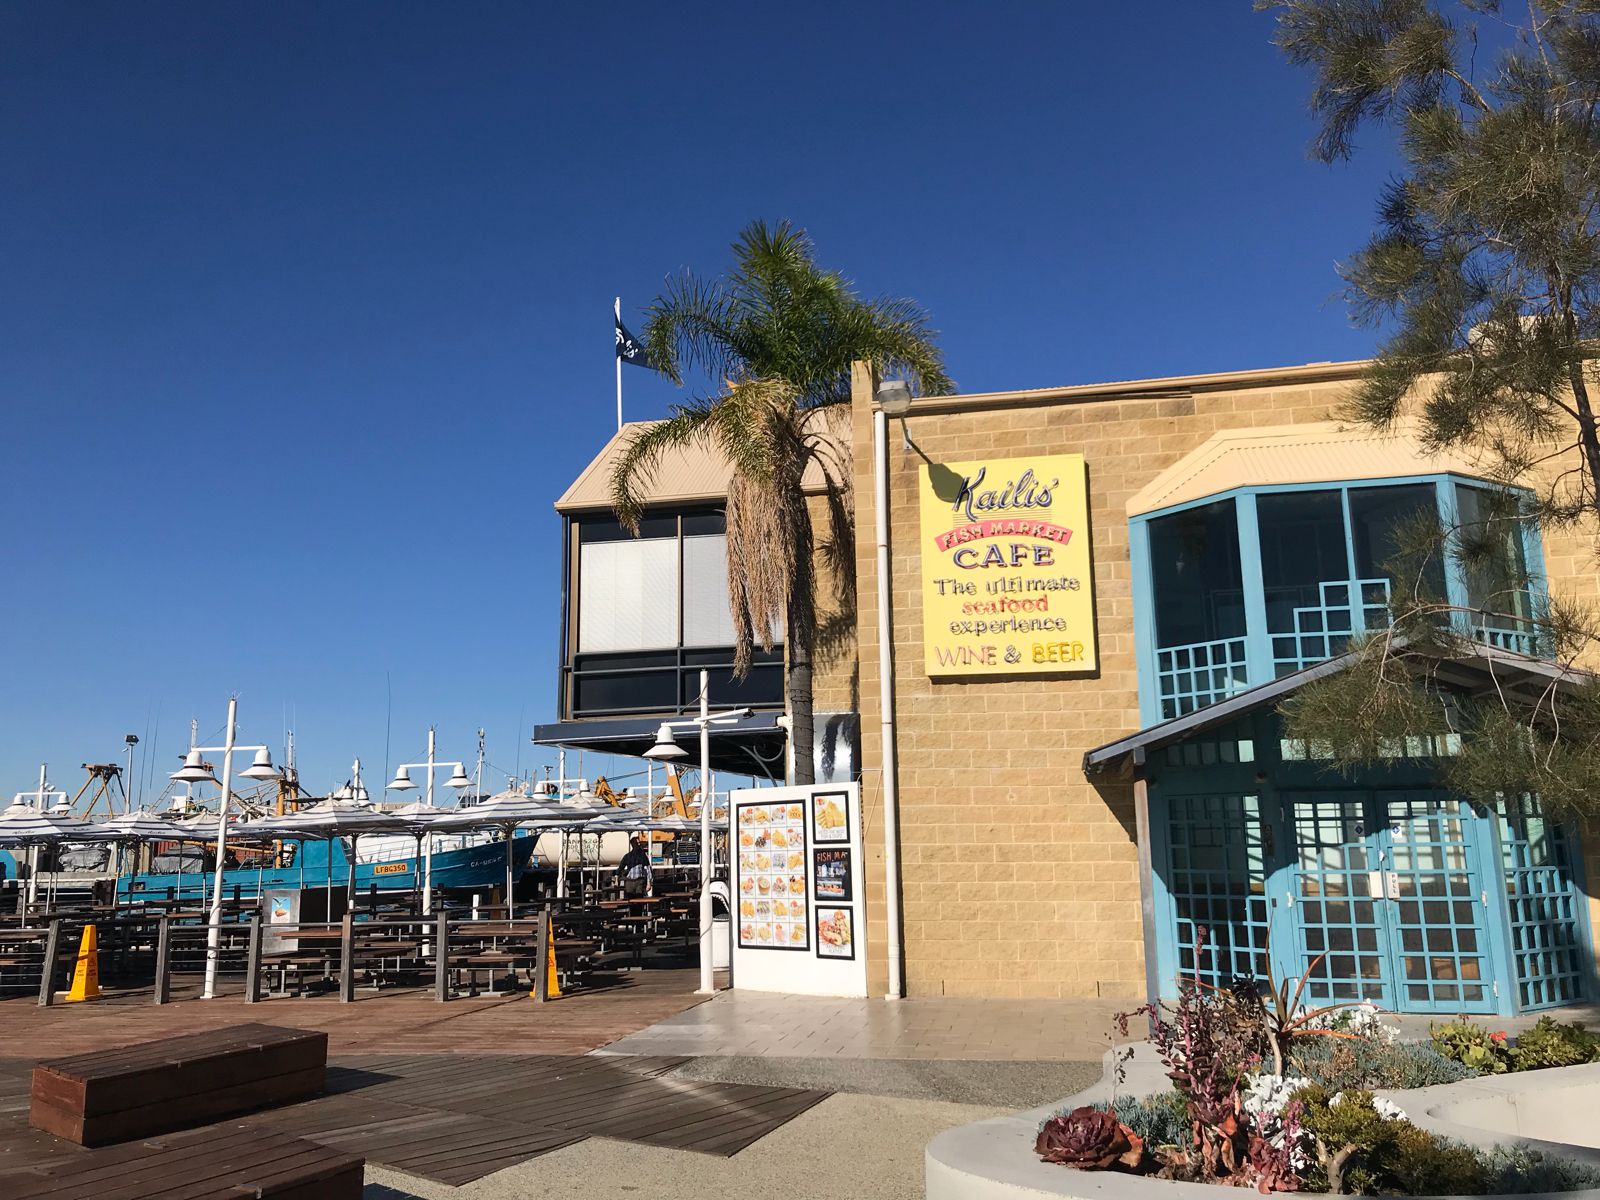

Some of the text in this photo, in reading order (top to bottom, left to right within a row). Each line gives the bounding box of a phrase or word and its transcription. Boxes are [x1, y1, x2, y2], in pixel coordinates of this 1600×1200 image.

[953, 464, 1060, 522] Kailis'
[942, 520, 1068, 549] FISH MARKET
[953, 543, 1055, 569] CAFE
[932, 575, 1081, 596] The ultimate
[961, 593, 1049, 614] seafood
[949, 614, 1067, 637] experience
[934, 640, 1085, 667] WINE & BEER
[816, 851, 832, 862] FISH
